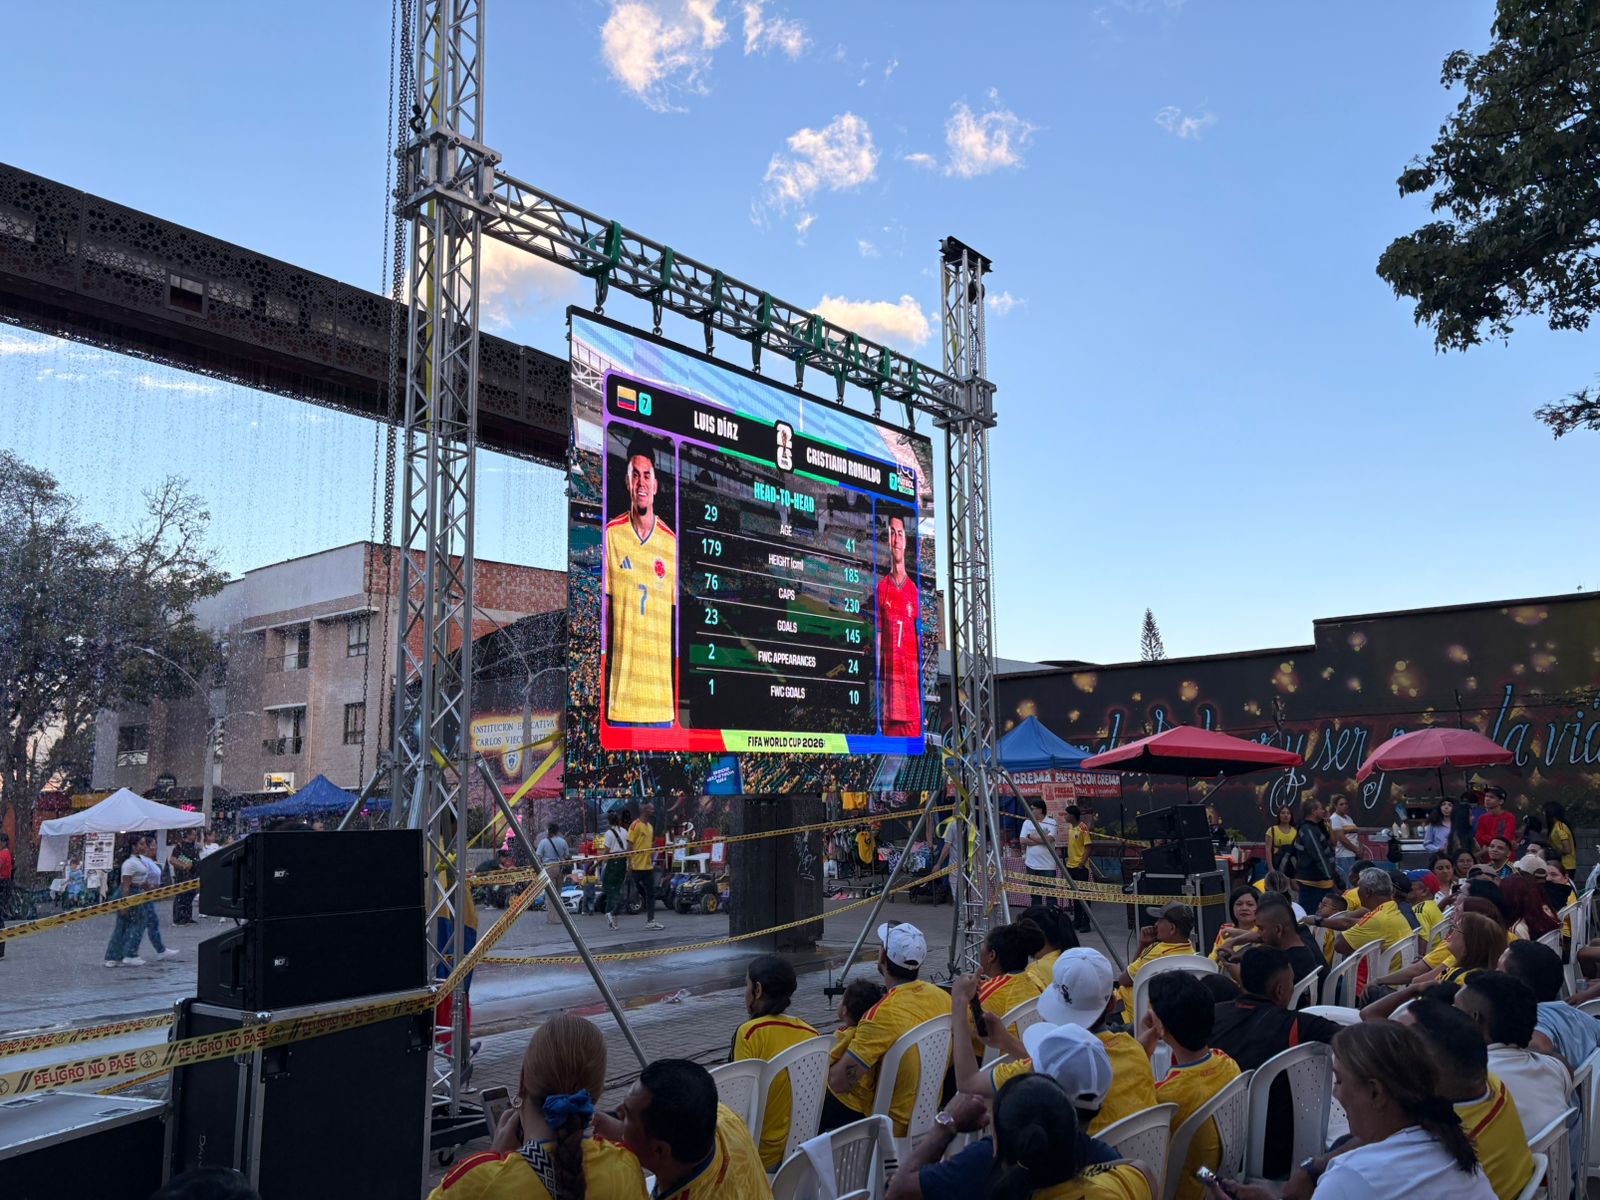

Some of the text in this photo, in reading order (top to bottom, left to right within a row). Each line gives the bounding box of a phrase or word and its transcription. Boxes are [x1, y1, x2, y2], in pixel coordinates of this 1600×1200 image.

[642, 397, 648, 410] 7
[693, 410, 739, 441] LUIS DÍAZ
[806, 446, 848, 475] CRISTIANO
[848, 459, 882, 485] RONALDO
[753, 481, 815, 513] HEAD-TO-HEAD
[704, 504, 718, 522] 29
[780, 524, 793, 537] AGE
[701, 538, 722, 557] 179
[845, 538, 856, 553] 41
[768, 553, 804, 571] HEIGHT (cm)
[704, 573, 719, 590] 76
[844, 568, 859, 584] 185
[638, 584, 648, 615] 7
[778, 588, 795, 600] CAPS
[844, 598, 860, 614] 230
[704, 608, 719, 625] 23
[777, 620, 797, 633] GOALS
[896, 620, 903, 648] 7
[845, 628, 861, 644] 145
[708, 643, 715, 660] 2
[757, 650, 816, 668] FWC APPEARANCES
[848, 659, 859, 674] 24
[708, 678, 714, 695] 1
[770, 685, 806, 699] FWC GOALS
[849, 690, 860, 705] 10
[475, 736, 502, 747] CARLOS
[747, 736, 824, 748] FIFA WORLD CUP 2026
[1310, 727, 1368, 771] ser
[302, 1009, 377, 1032] PELIGRO NO PASE
[19, 1037, 35, 1048] NO
[178, 1030, 269, 1058] PELIGRO NO PASE
[33, 1056, 137, 1086] PELIGRO NO PASE
